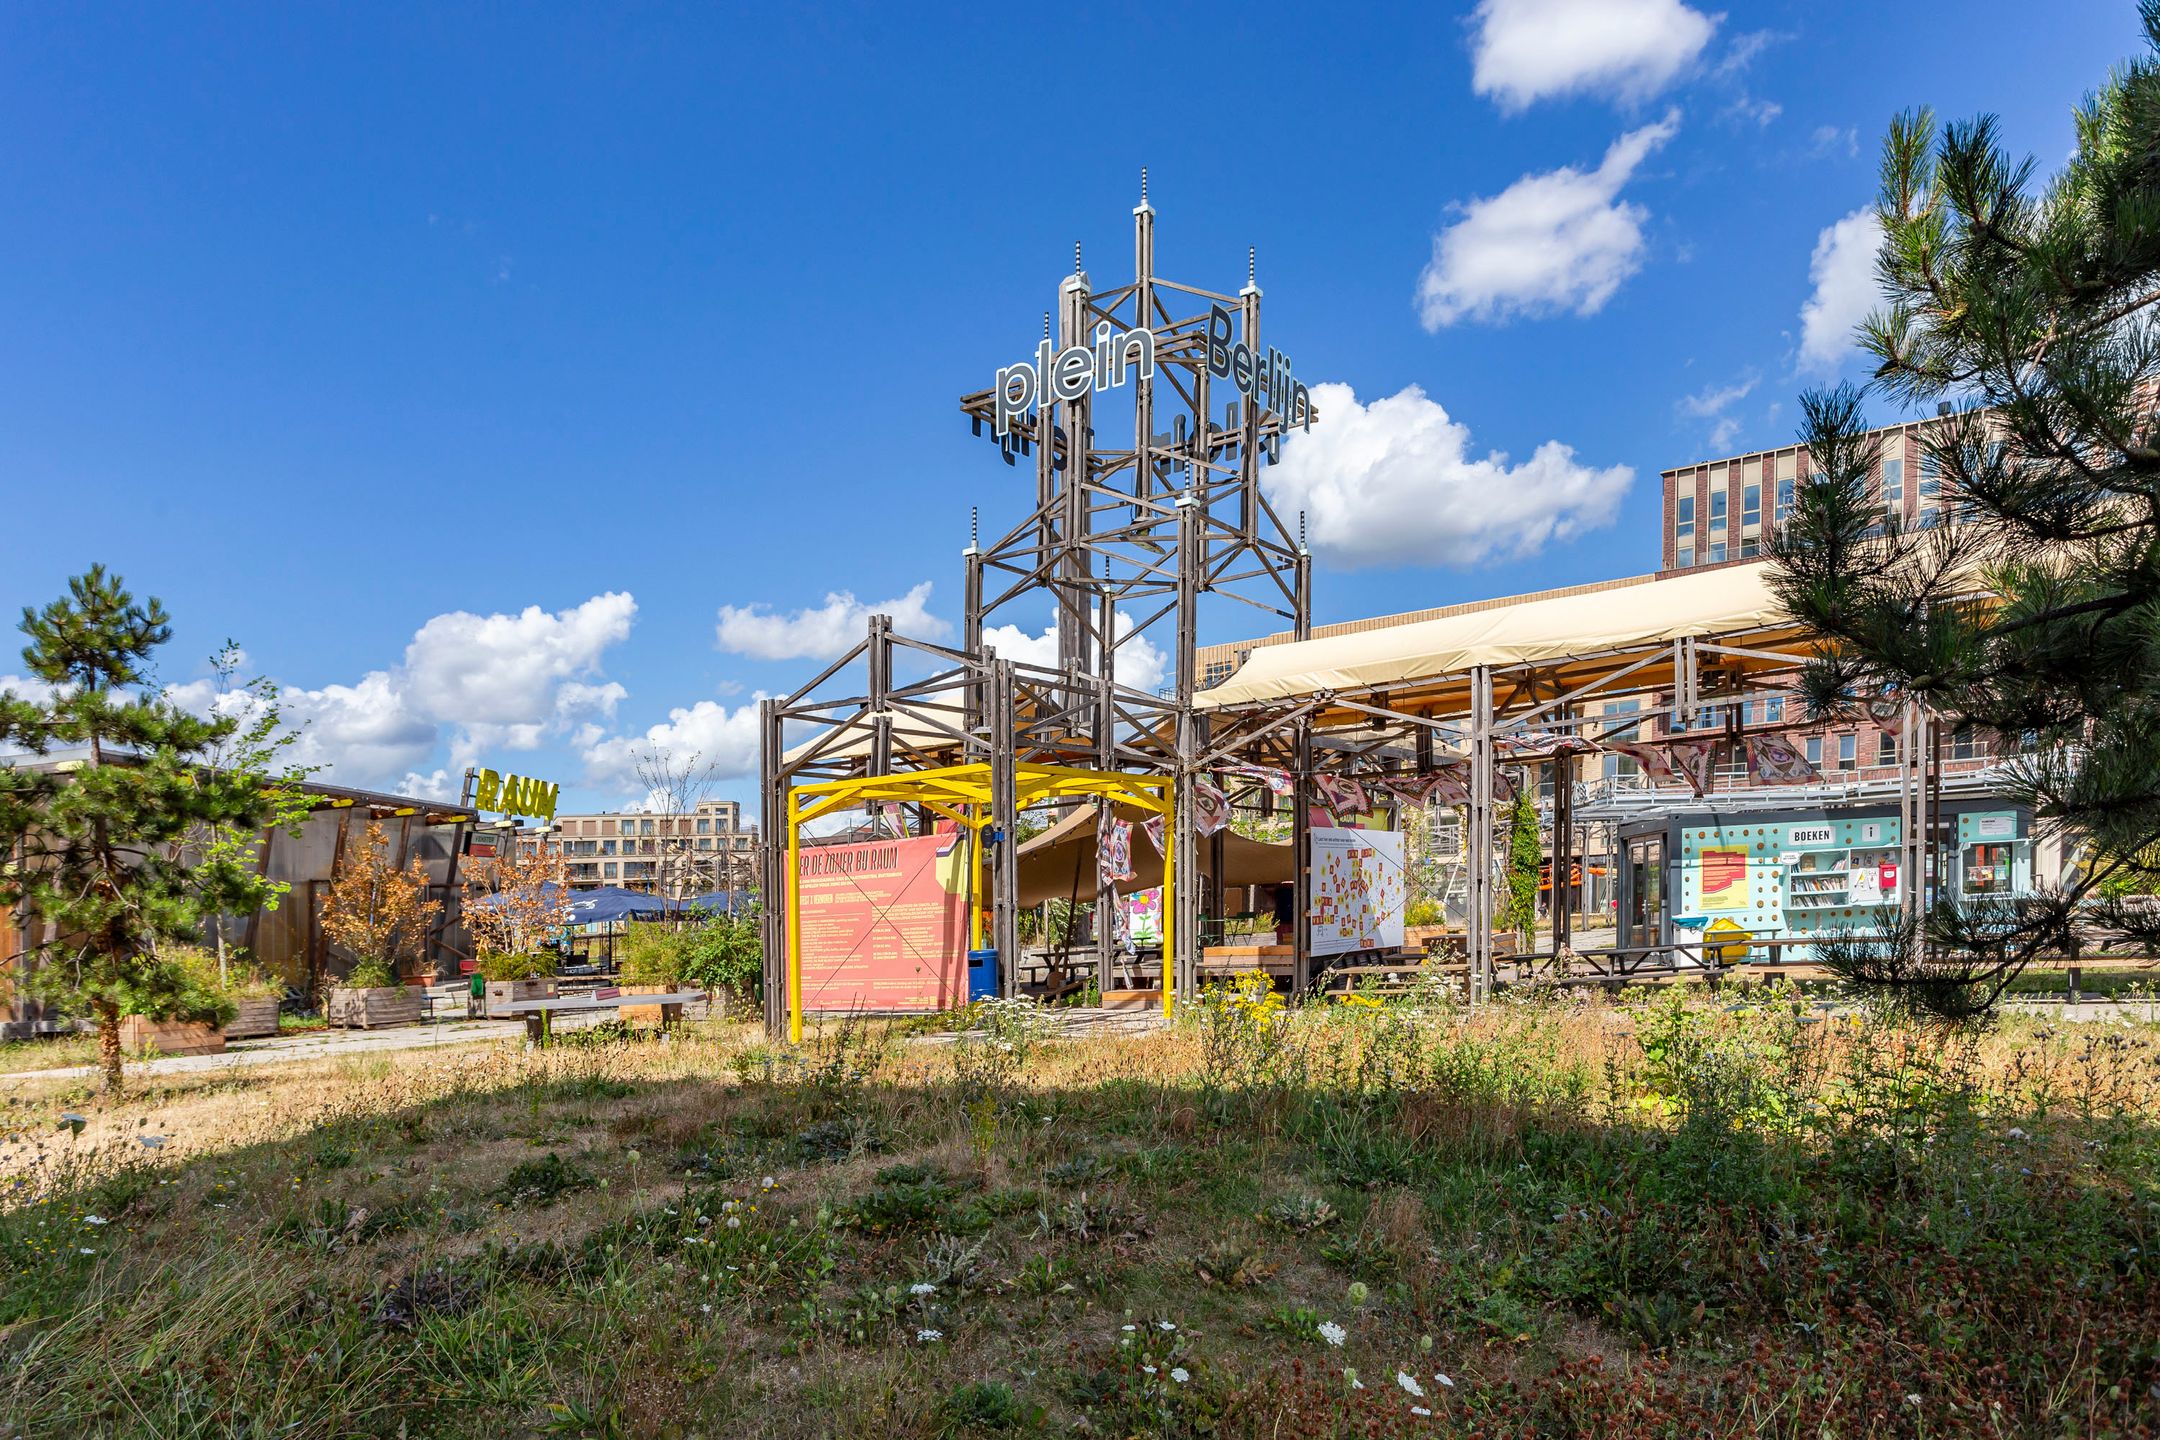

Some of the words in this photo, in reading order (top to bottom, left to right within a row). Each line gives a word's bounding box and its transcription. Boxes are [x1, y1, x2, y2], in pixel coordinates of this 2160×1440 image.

[996, 320, 1155, 436] plein
[1207, 302, 1311, 435] Berlijn
[475, 768, 559, 821] RAUM
[812, 854, 823, 875] DE
[824, 851, 854, 874] ZOMER
[870, 847, 899, 870] RAUM
[1794, 830, 1830, 842] BOEKEN
